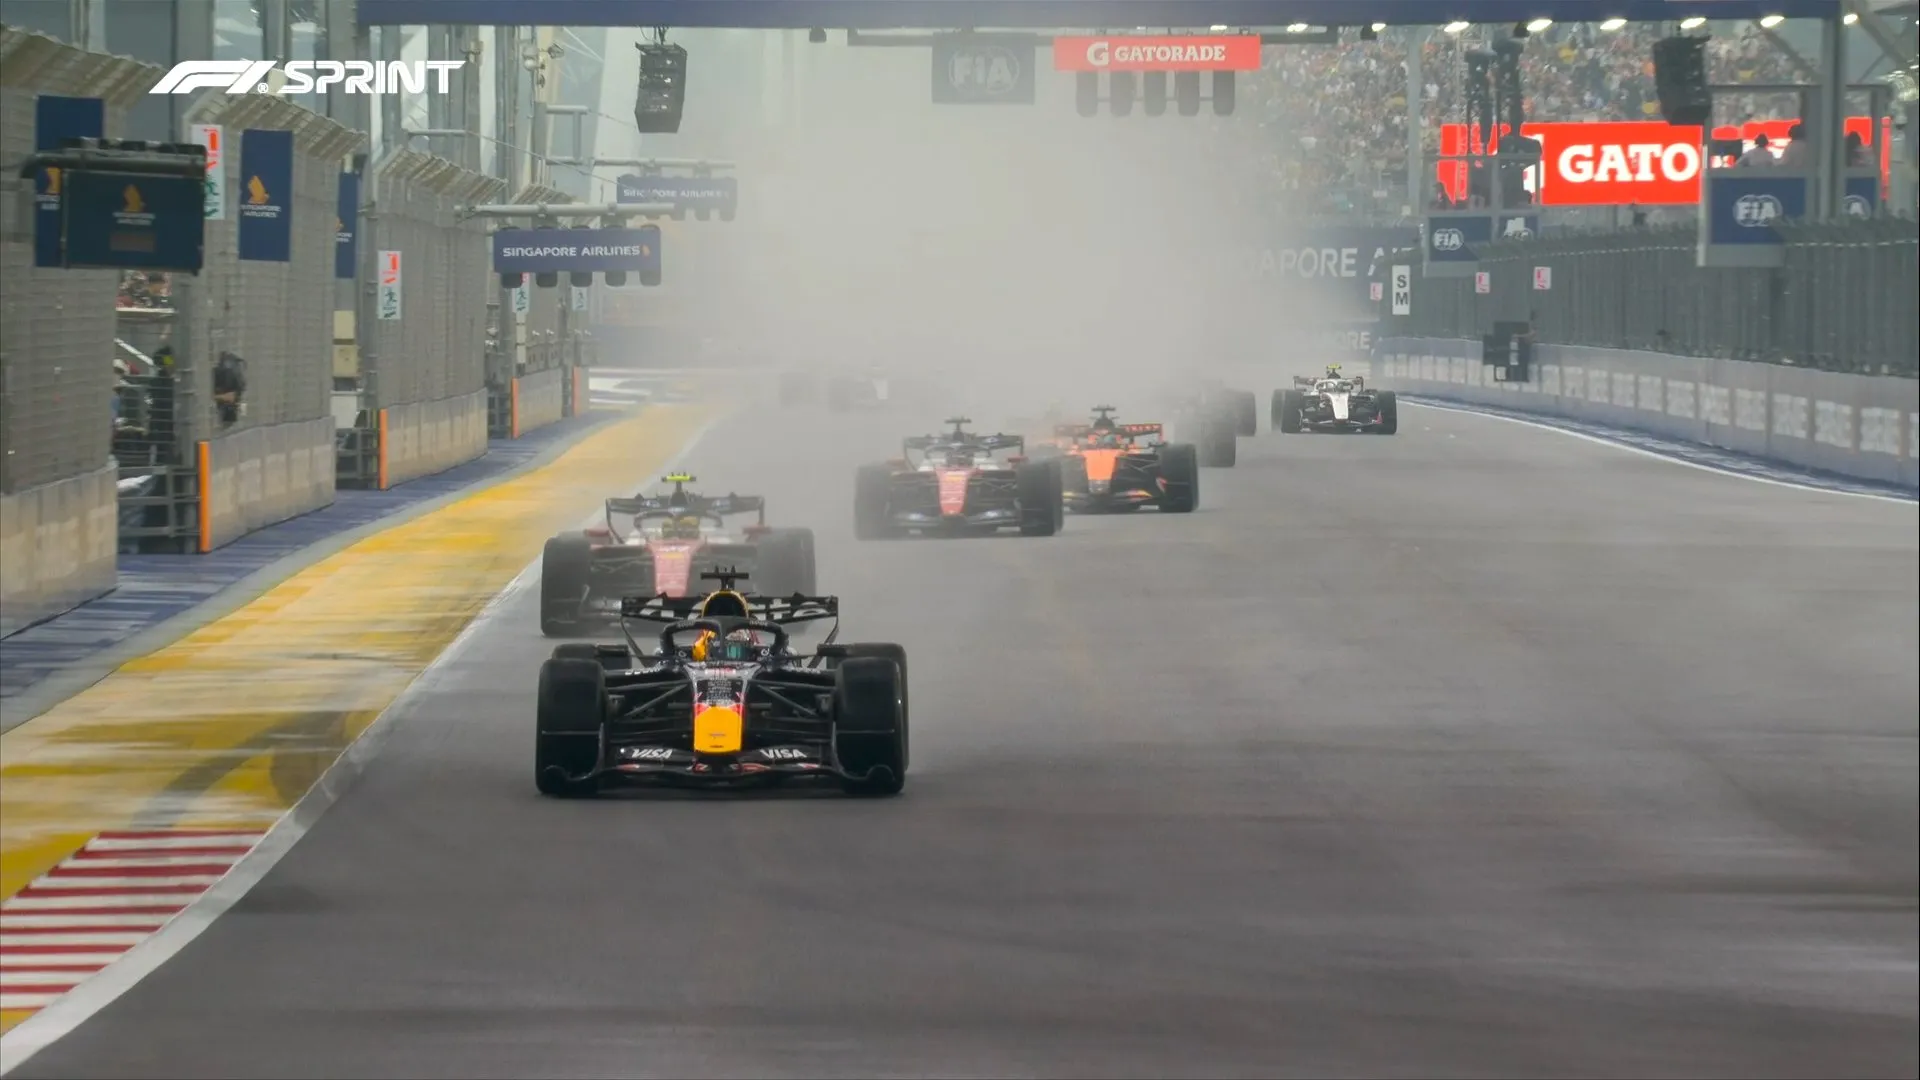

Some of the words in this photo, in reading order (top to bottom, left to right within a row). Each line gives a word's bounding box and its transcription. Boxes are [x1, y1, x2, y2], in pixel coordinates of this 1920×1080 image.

[1114, 45, 1226, 62] GATORADE
[953, 52, 1014, 85] FIA
[1558, 142, 1708, 183] GATO
[1735, 201, 1776, 220] FIA
[1434, 232, 1460, 247] FIA
[502, 246, 577, 257] SINGAPORE
[581, 245, 641, 256] AIRLINES
[631, 748, 673, 760] VISA
[759, 748, 807, 760] VISA
